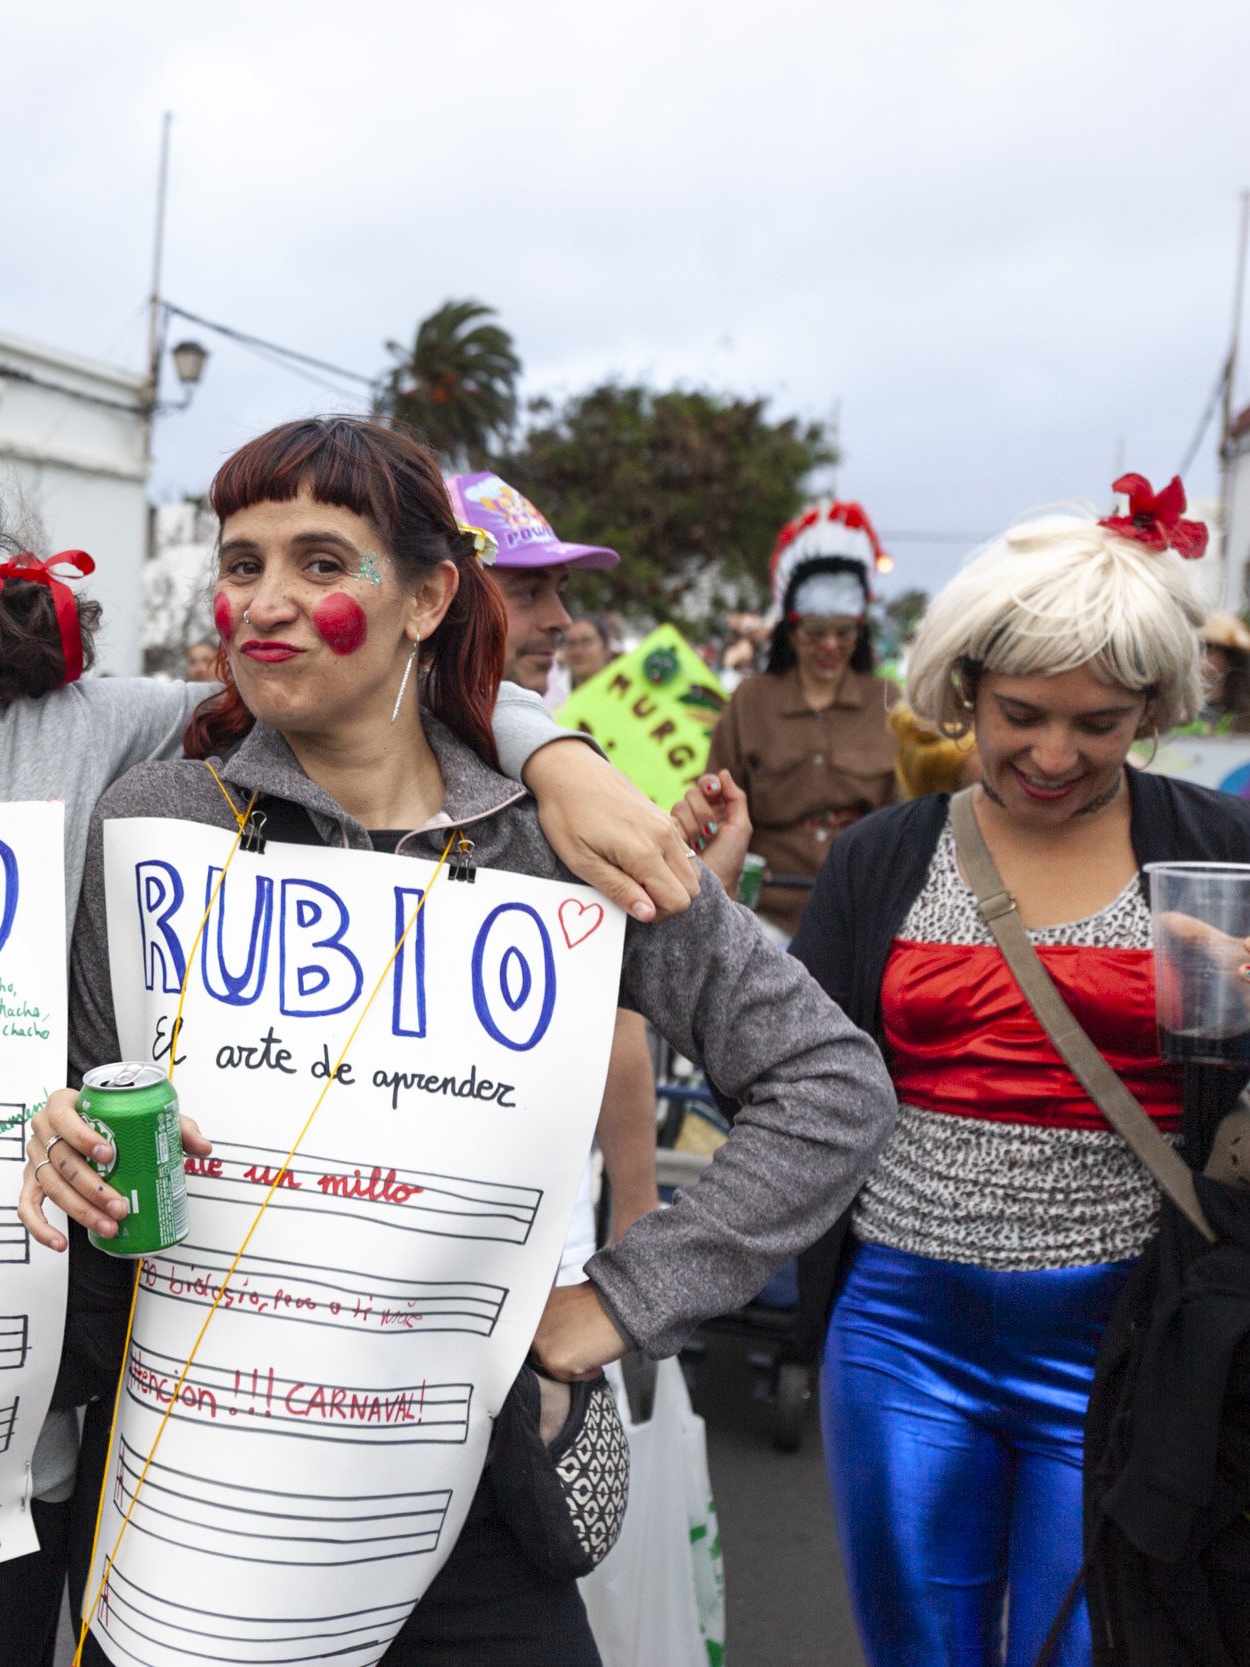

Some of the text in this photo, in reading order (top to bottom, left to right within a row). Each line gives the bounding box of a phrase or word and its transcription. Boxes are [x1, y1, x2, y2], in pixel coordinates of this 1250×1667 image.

[135, 859, 557, 1052] RUBIO
[152, 1016, 517, 1110] El arte de aprender
[243, 1164, 302, 1190] un
[317, 1166, 425, 1204] millo
